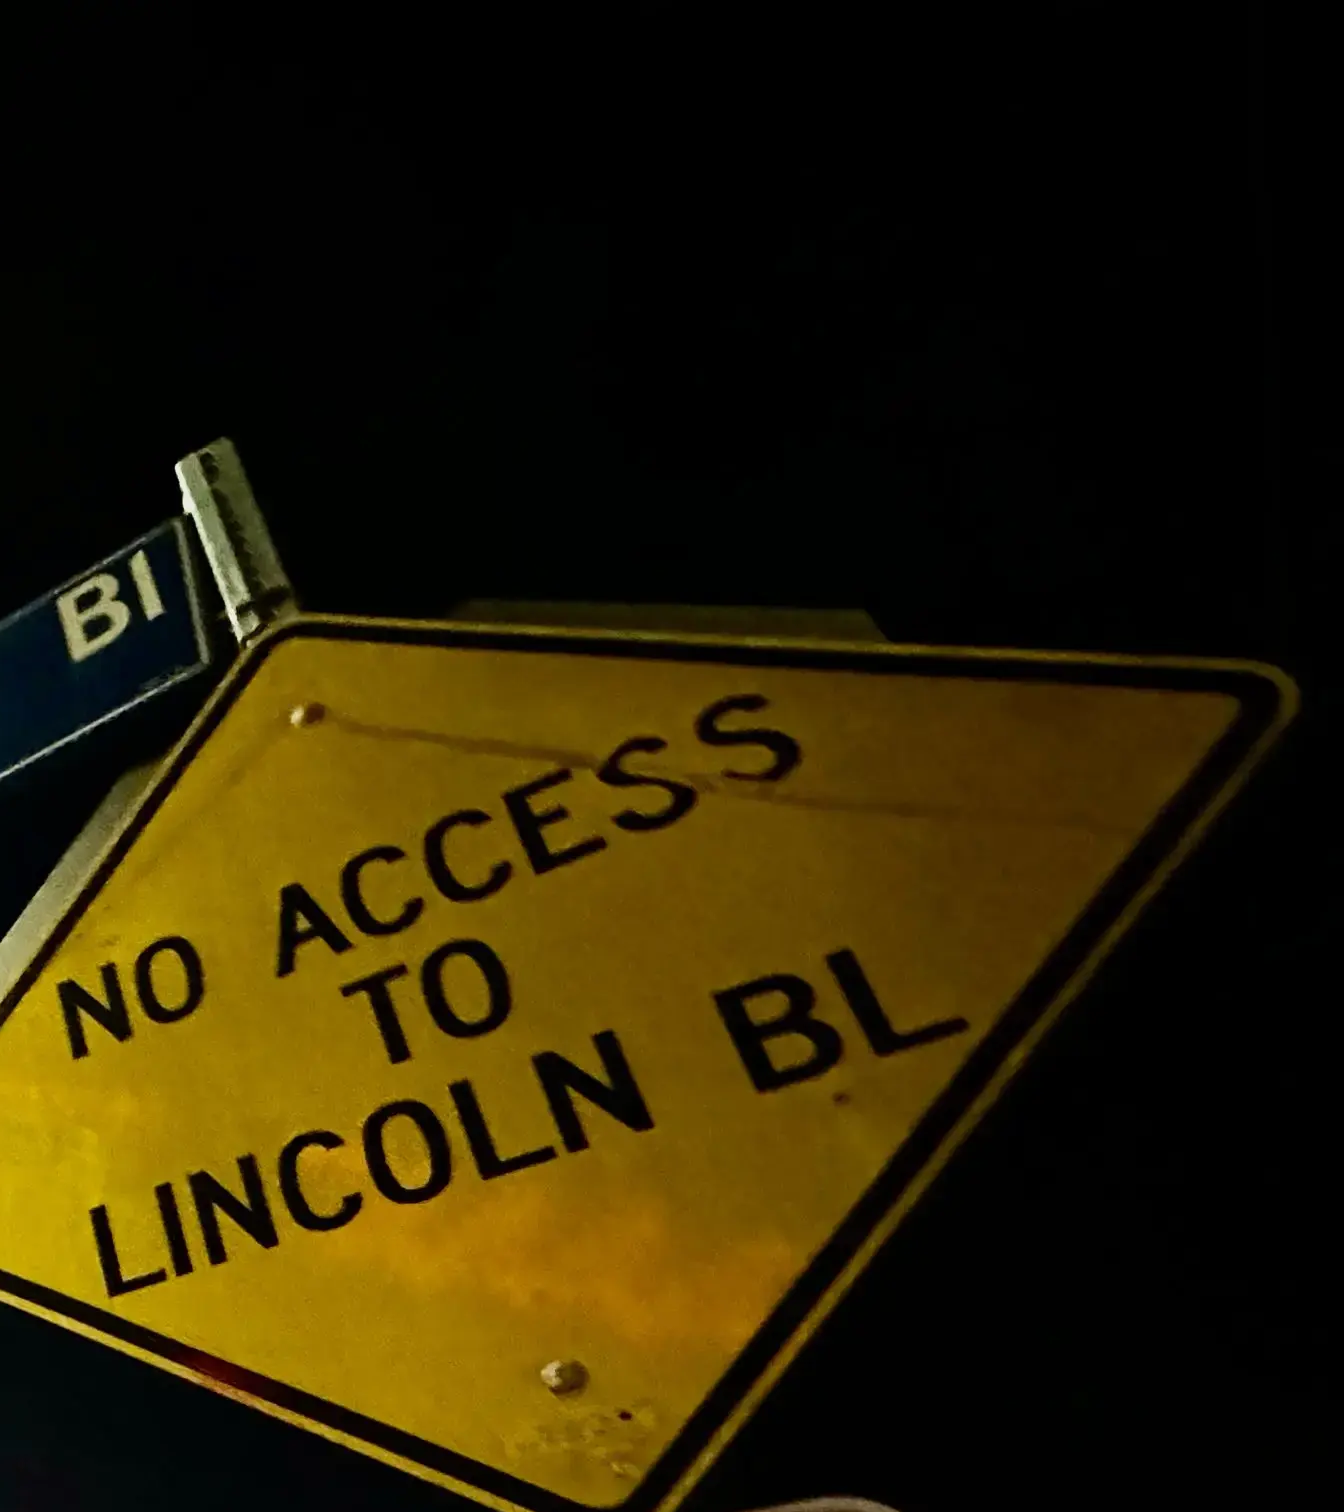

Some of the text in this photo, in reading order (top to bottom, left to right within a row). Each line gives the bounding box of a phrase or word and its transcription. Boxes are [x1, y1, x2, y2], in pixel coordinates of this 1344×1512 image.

[56, 549, 167, 662] Bl
[56, 692, 802, 1060] NO ACCESS
[340, 938, 513, 1065] TO
[88, 946, 971, 1298] LINCOLN BL
